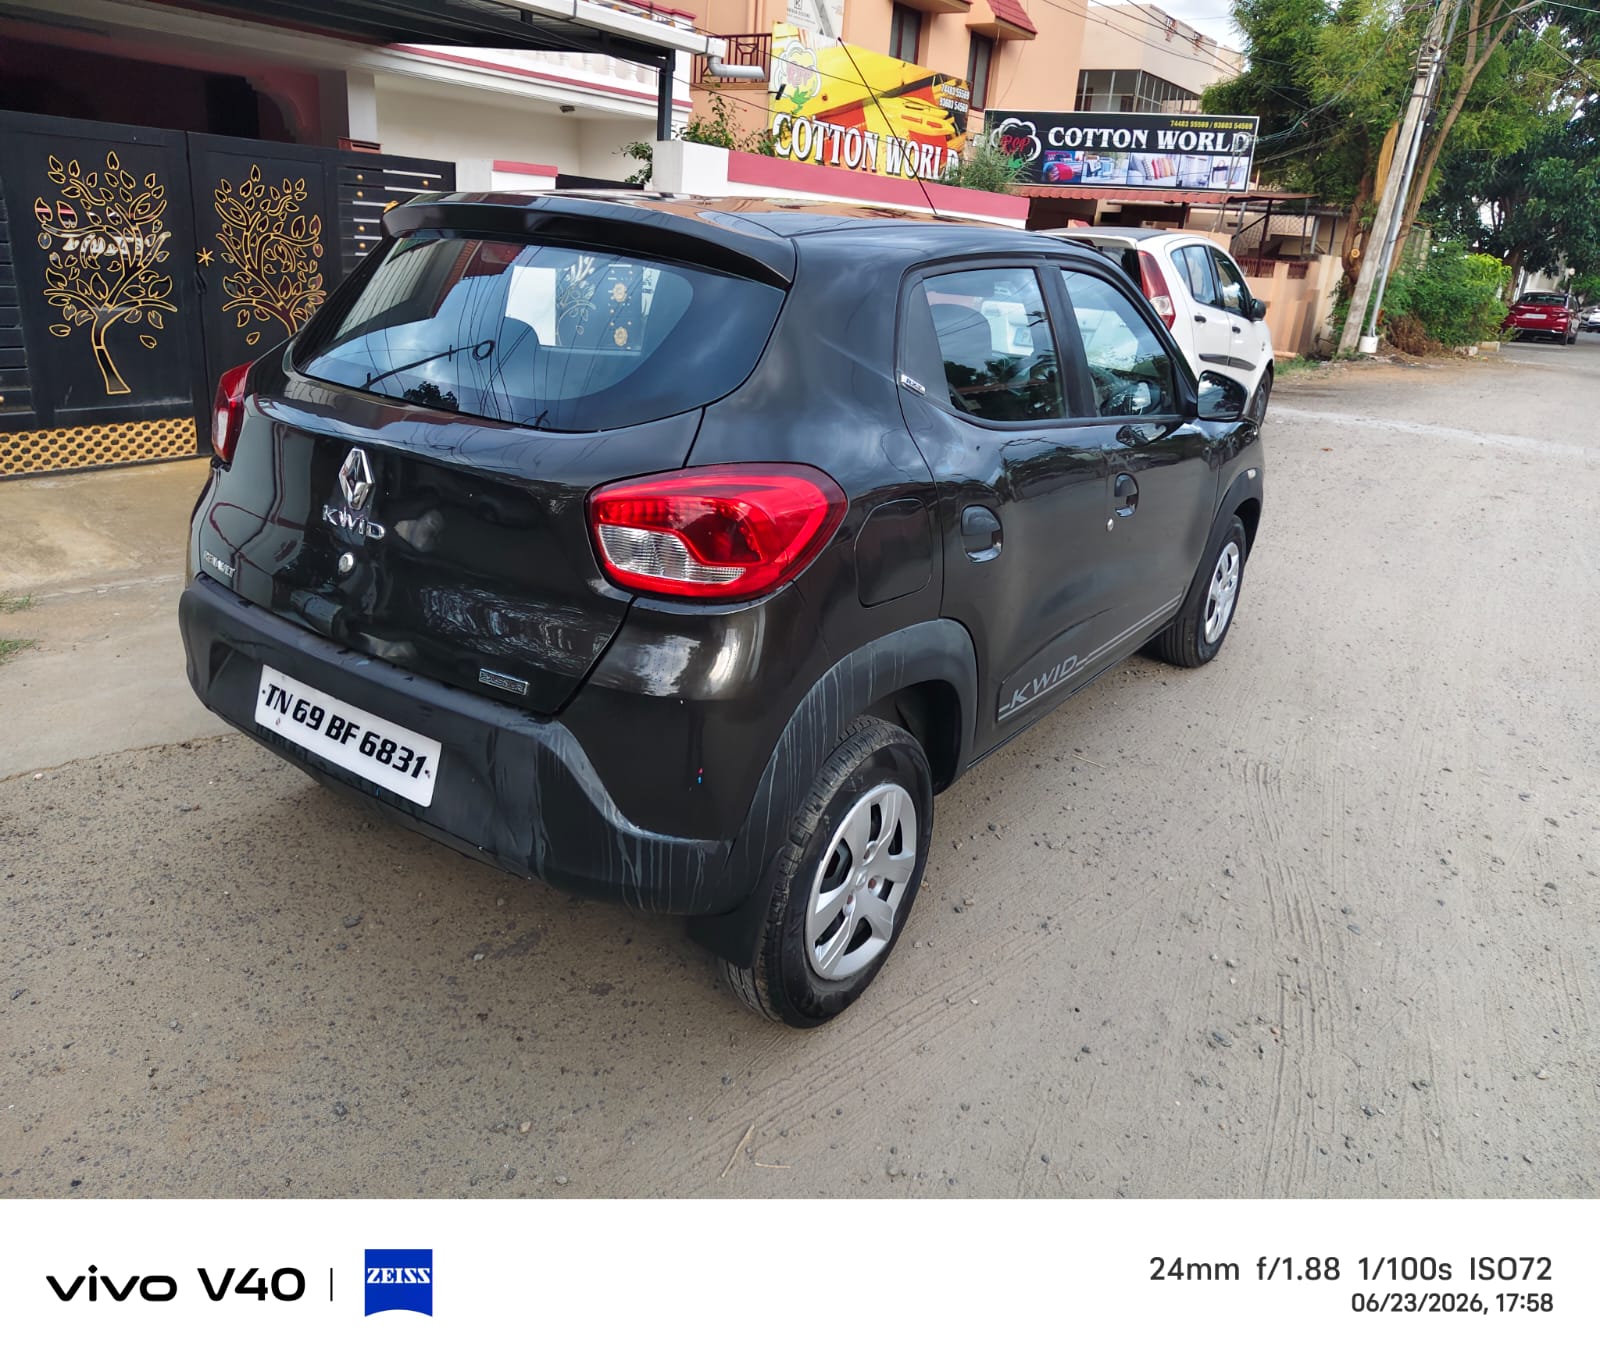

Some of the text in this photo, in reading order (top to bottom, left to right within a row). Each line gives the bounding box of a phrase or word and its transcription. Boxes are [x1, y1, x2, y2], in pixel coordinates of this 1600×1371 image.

[772, 112, 878, 173] COTTON
[1048, 126, 1250, 153] COTTON WORLD
[322, 505, 386, 540] KWID
[1010, 655, 1078, 709] KWID
[265, 683, 428, 779] TN 69 BF 6831
